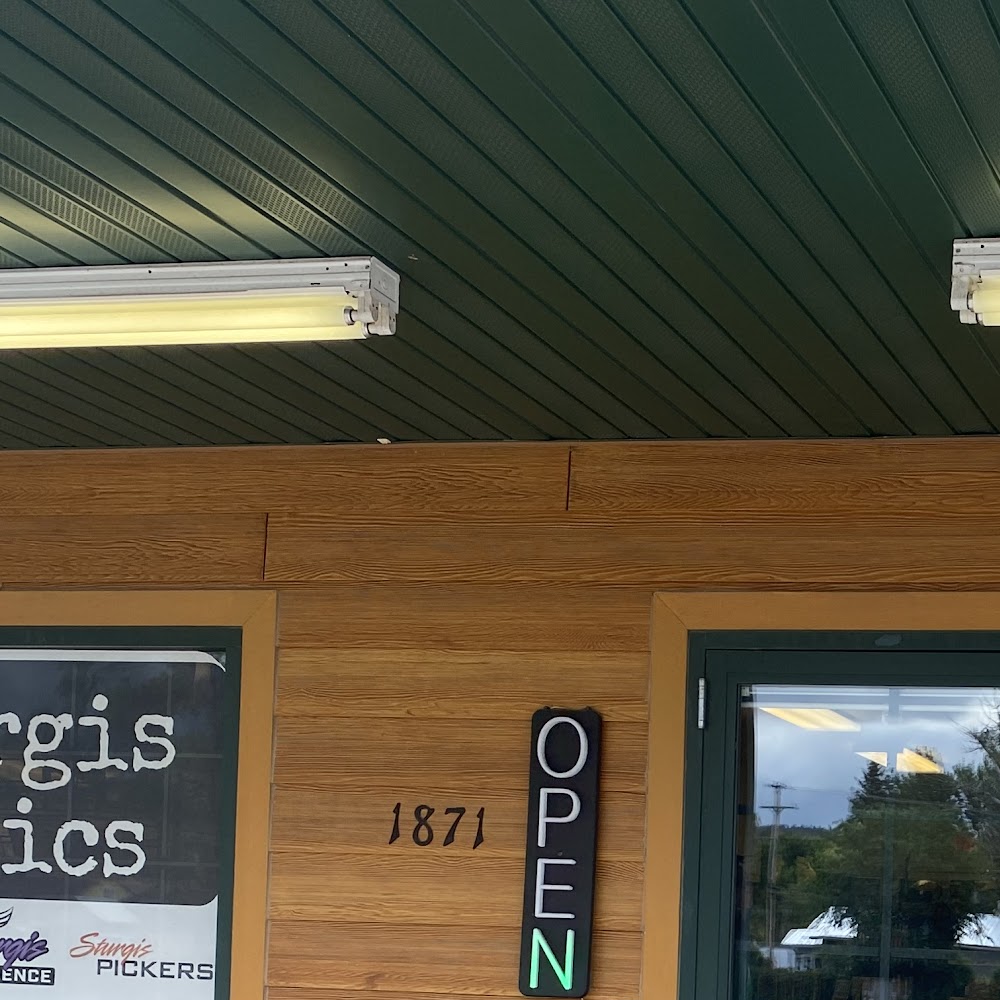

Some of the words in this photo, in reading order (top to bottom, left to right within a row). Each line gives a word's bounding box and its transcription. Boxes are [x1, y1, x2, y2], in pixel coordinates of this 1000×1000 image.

[388, 802, 485, 850] 1871
[530, 716, 589, 991] OPEN
[69, 932, 153, 965] Sturgis
[97, 958, 214, 980] PICKERS
